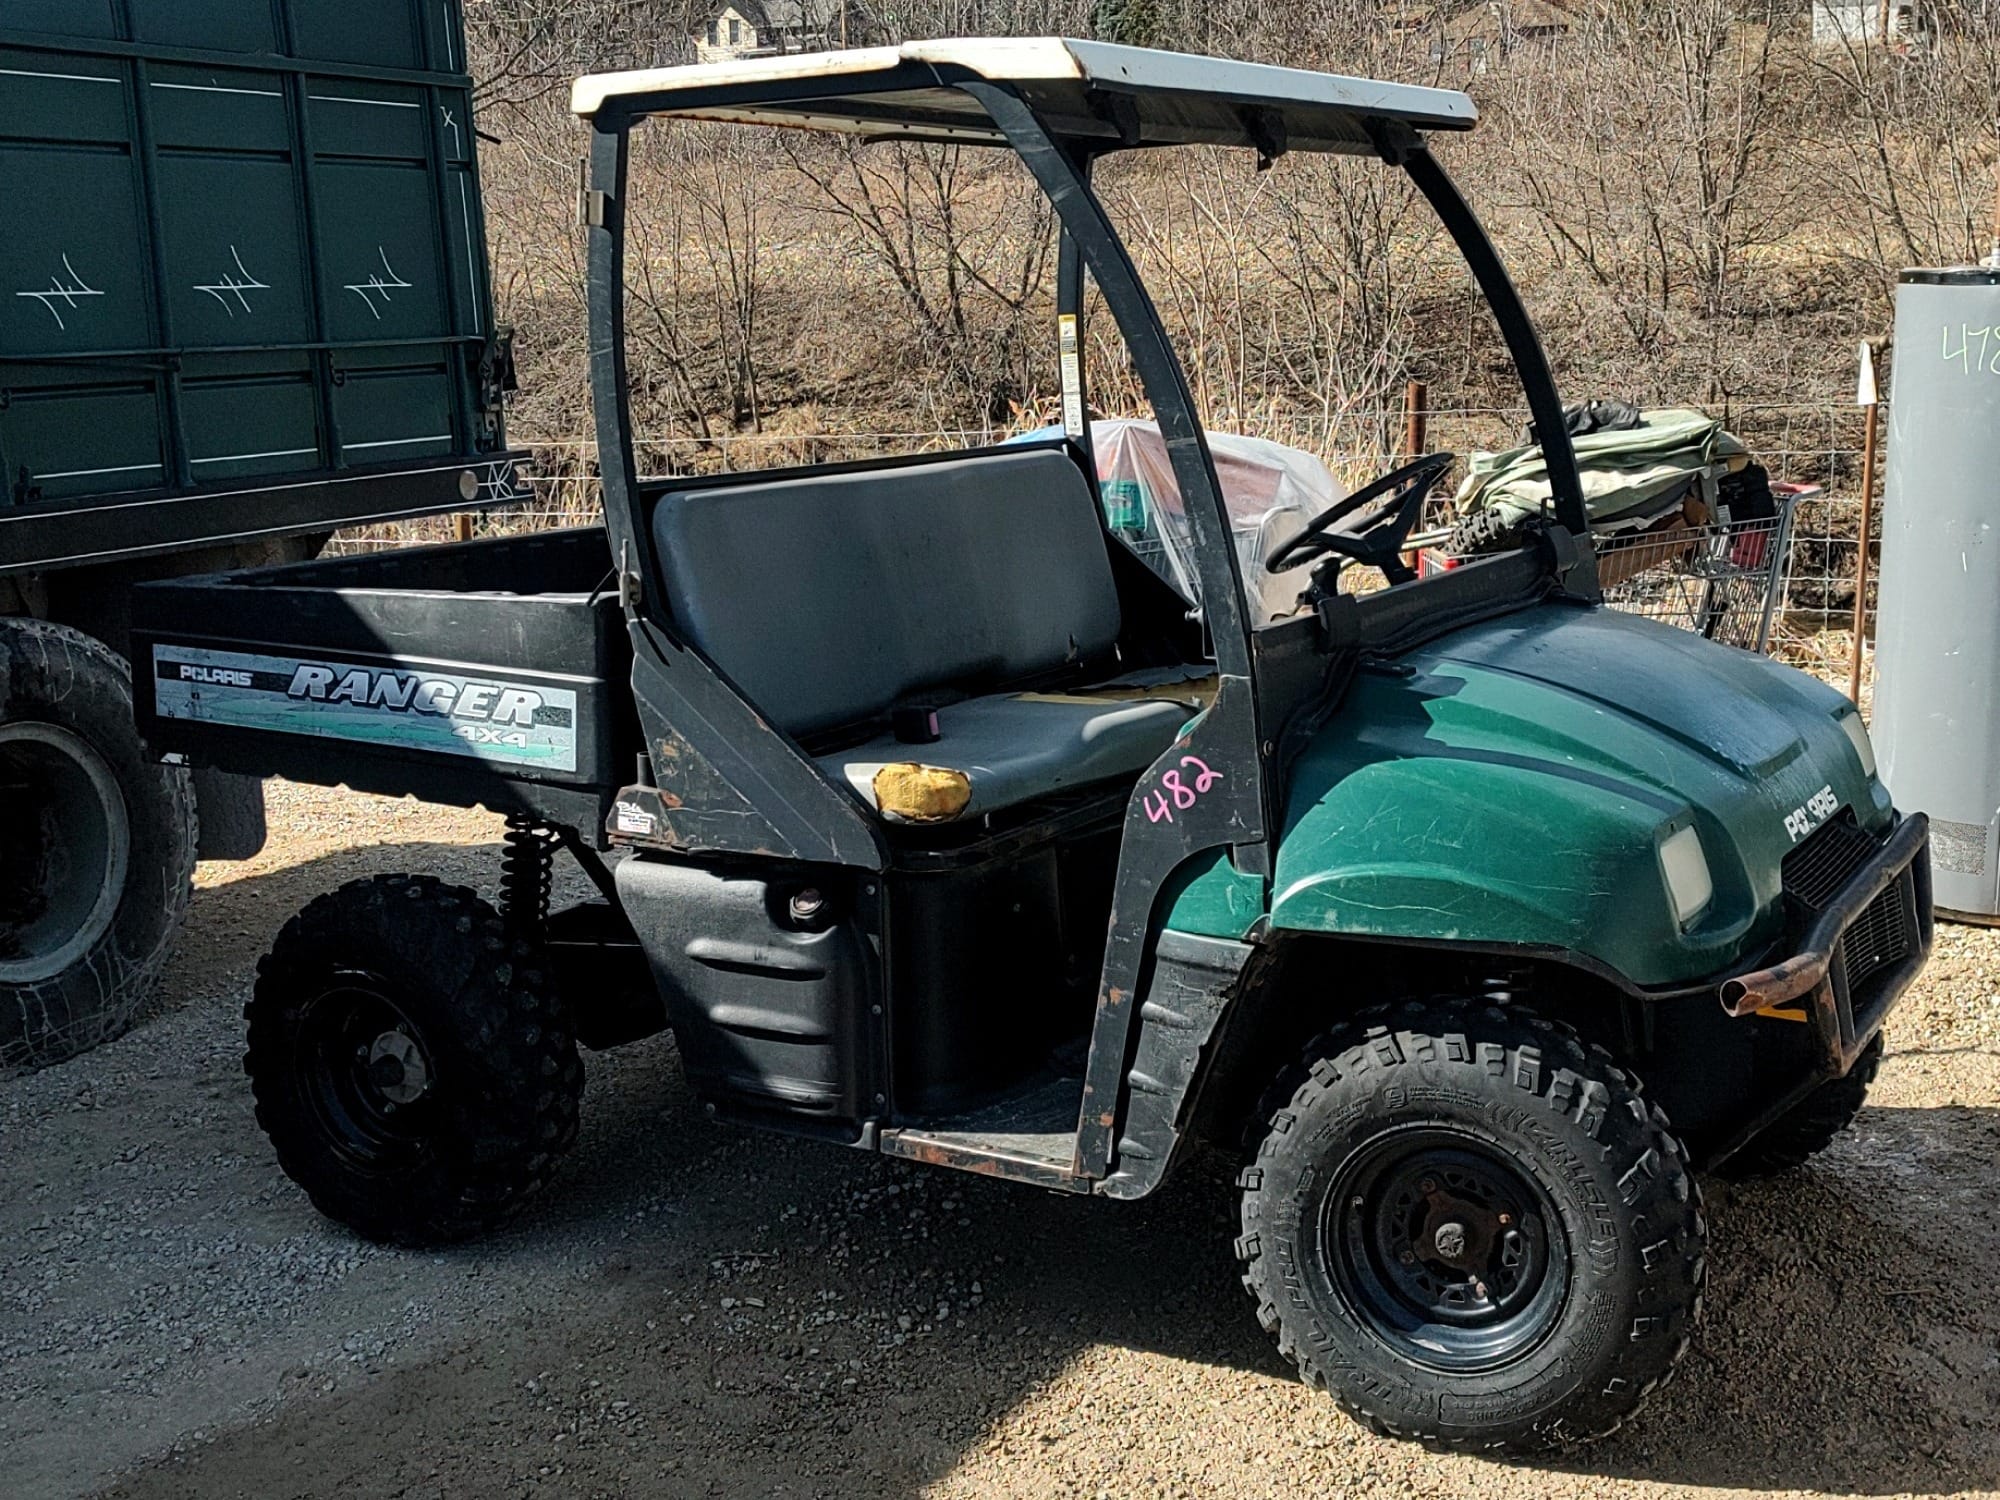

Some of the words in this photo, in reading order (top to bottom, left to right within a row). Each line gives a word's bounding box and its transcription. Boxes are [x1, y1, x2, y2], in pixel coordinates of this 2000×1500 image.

[180, 665, 253, 687] POLARIS
[287, 663, 543, 726] RANGER
[1143, 755, 1224, 824] 482
